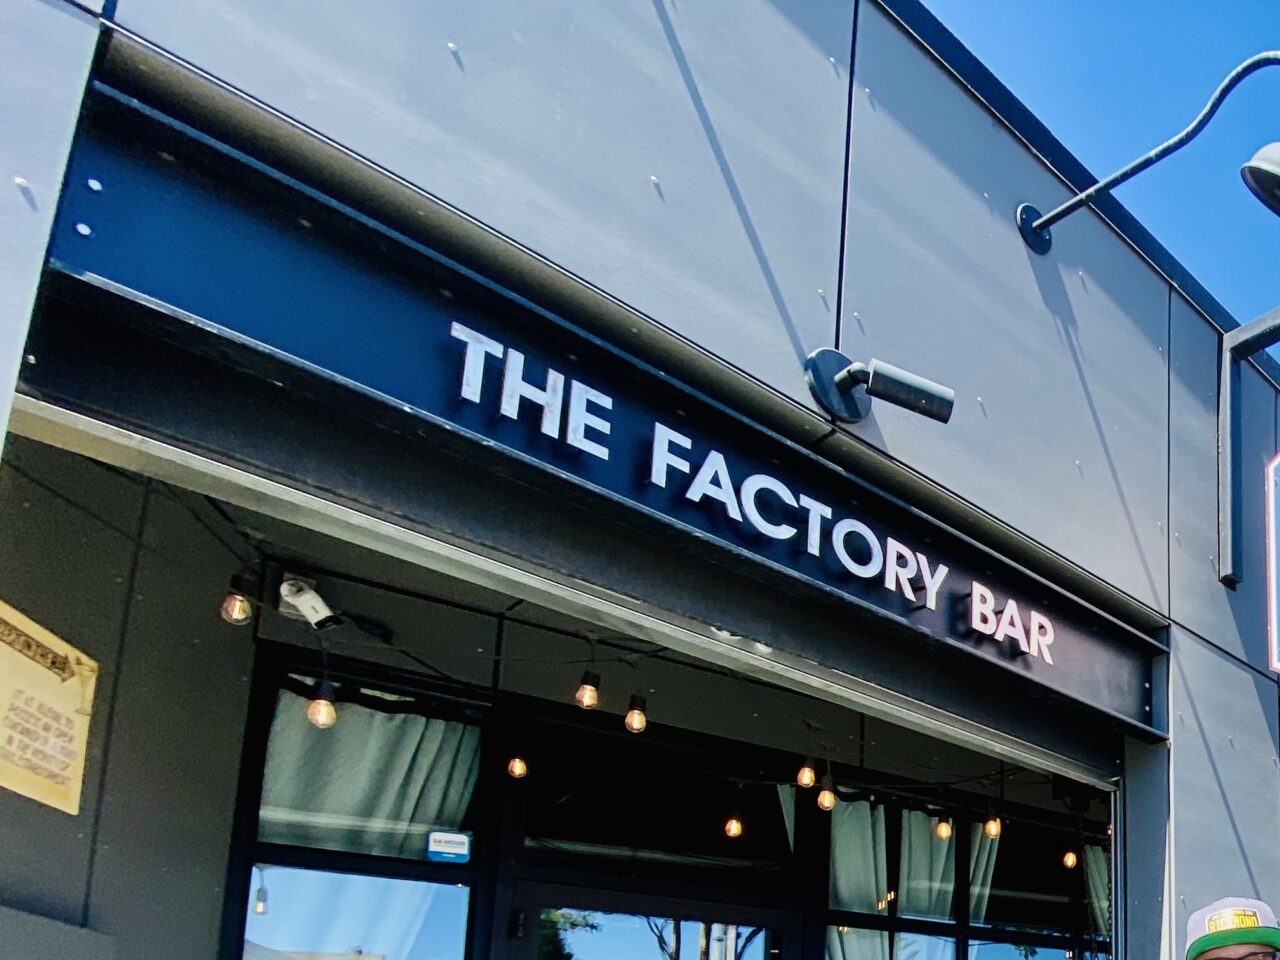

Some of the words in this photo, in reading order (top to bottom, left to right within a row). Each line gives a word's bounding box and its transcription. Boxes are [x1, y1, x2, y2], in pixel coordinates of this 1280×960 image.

[450, 321, 613, 460] THE
[651, 422, 948, 611] FACTORY
[971, 580, 1055, 665] BAR
